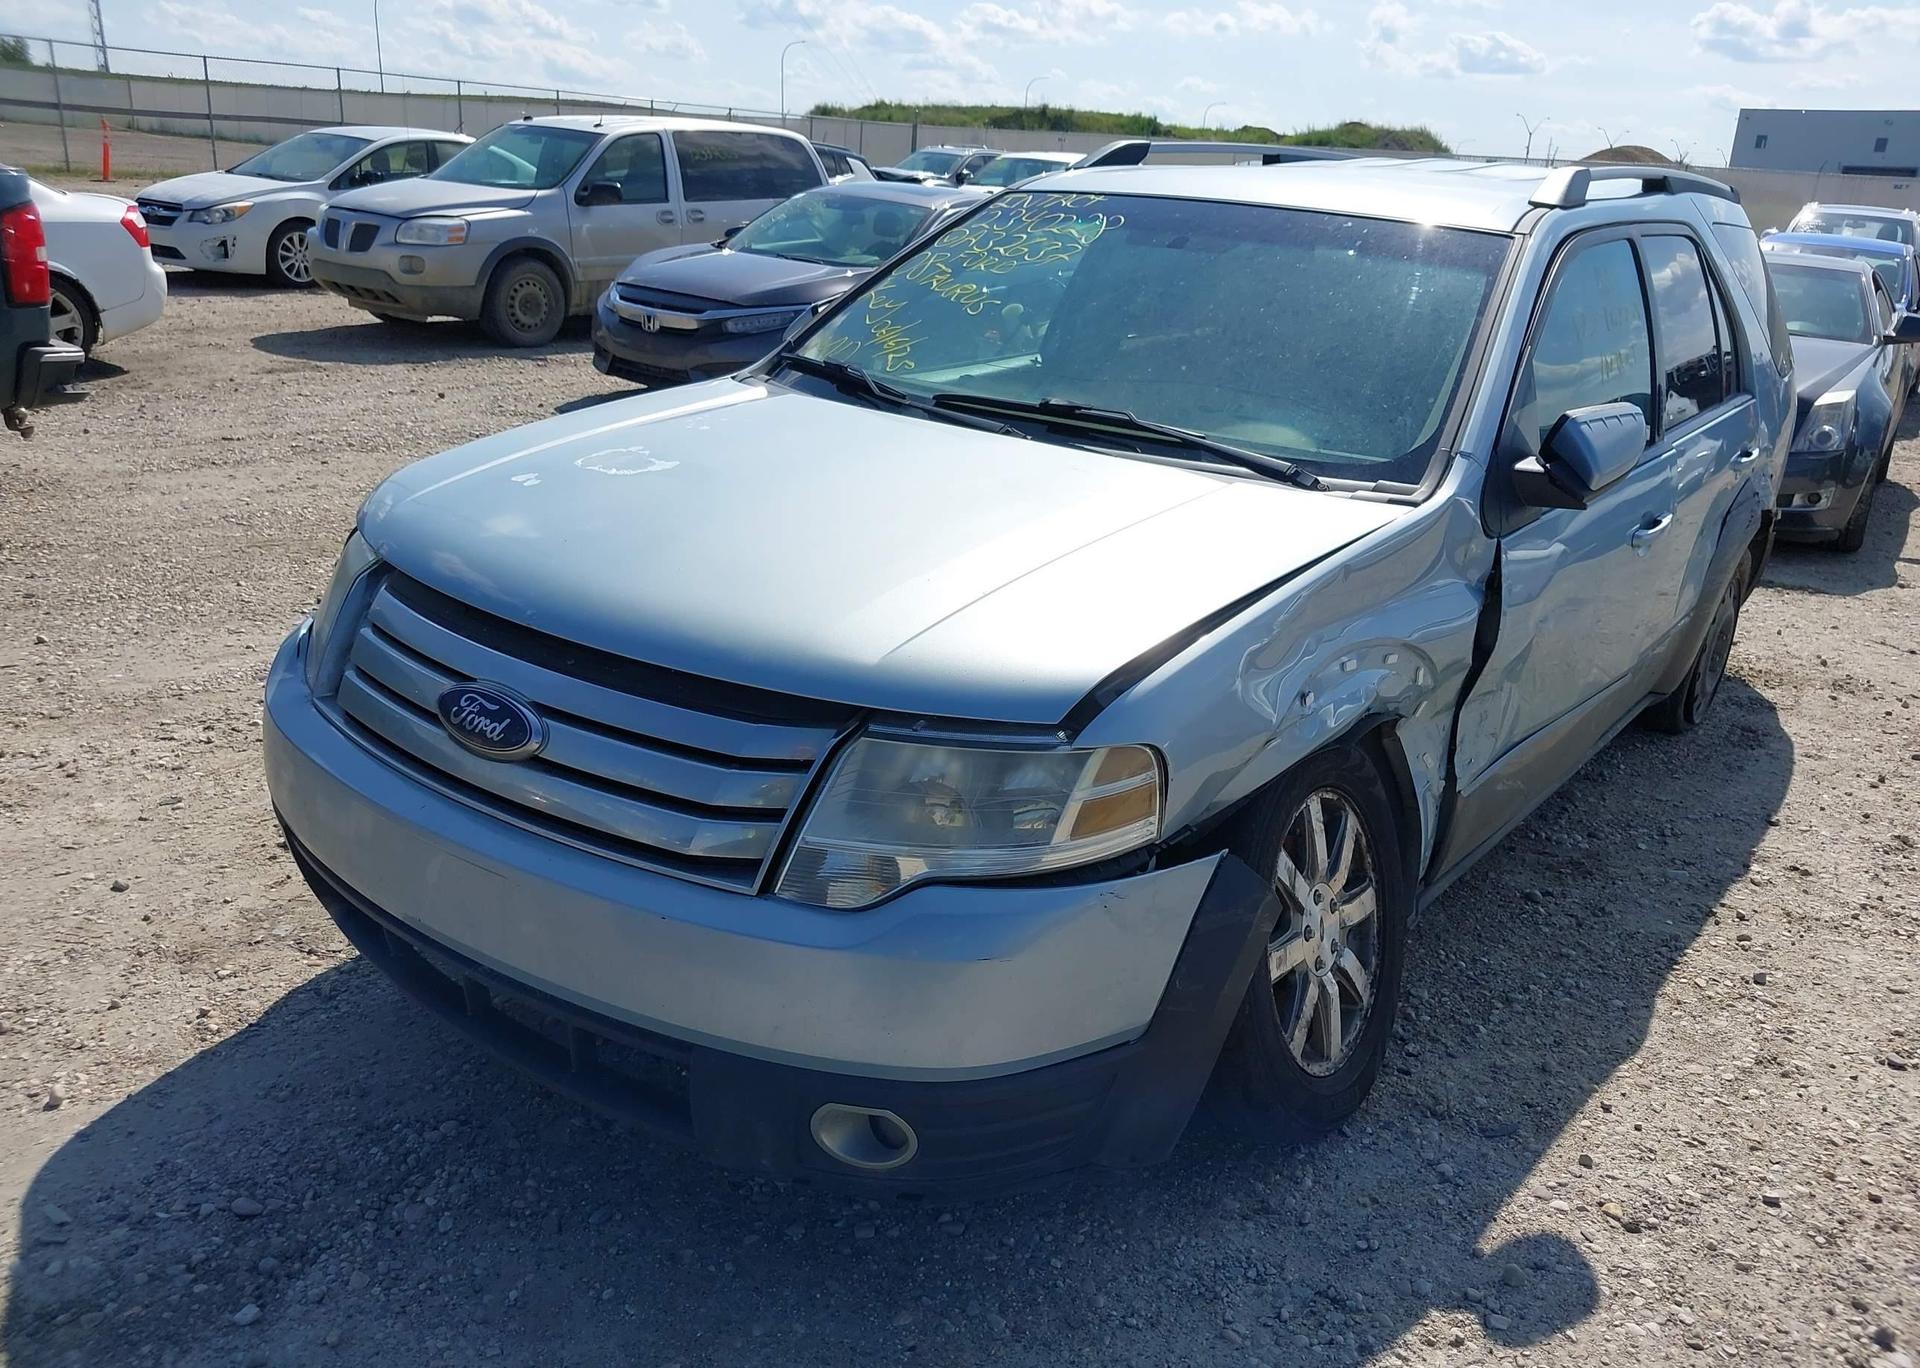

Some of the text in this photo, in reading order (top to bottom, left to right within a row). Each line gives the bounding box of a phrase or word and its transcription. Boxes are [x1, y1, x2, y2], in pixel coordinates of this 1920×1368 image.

[948, 250, 1017, 274] FORD
[919, 263, 1001, 315] TAURUS
[450, 693, 511, 742] Ford
